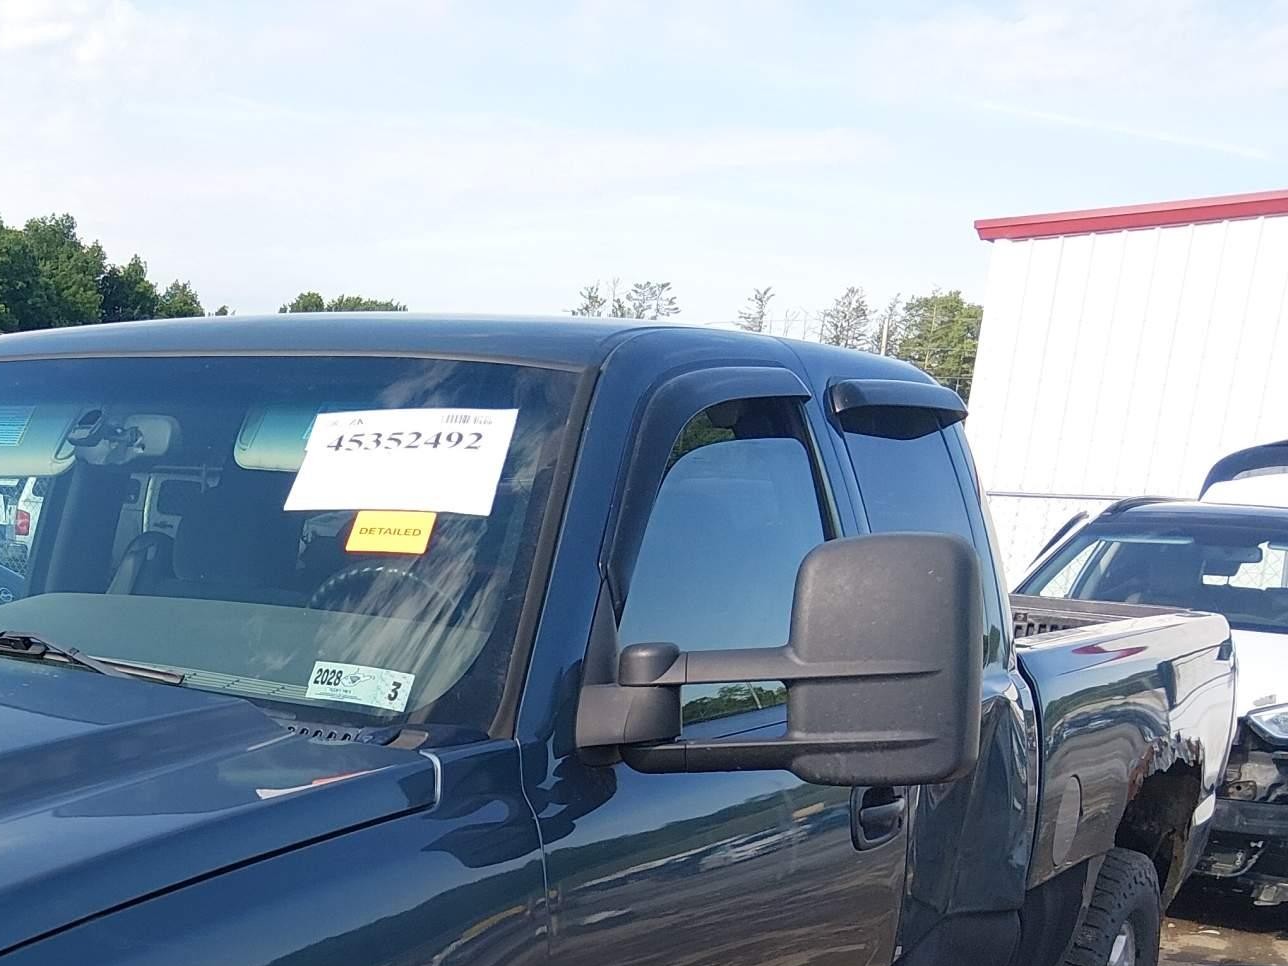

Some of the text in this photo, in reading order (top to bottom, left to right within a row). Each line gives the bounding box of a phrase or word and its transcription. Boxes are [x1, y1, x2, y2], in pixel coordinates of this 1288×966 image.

[327, 431, 483, 451] 45352492
[358, 527, 422, 536] DETAILED
[313, 667, 343, 687] 2028
[388, 681, 402, 701] 3
